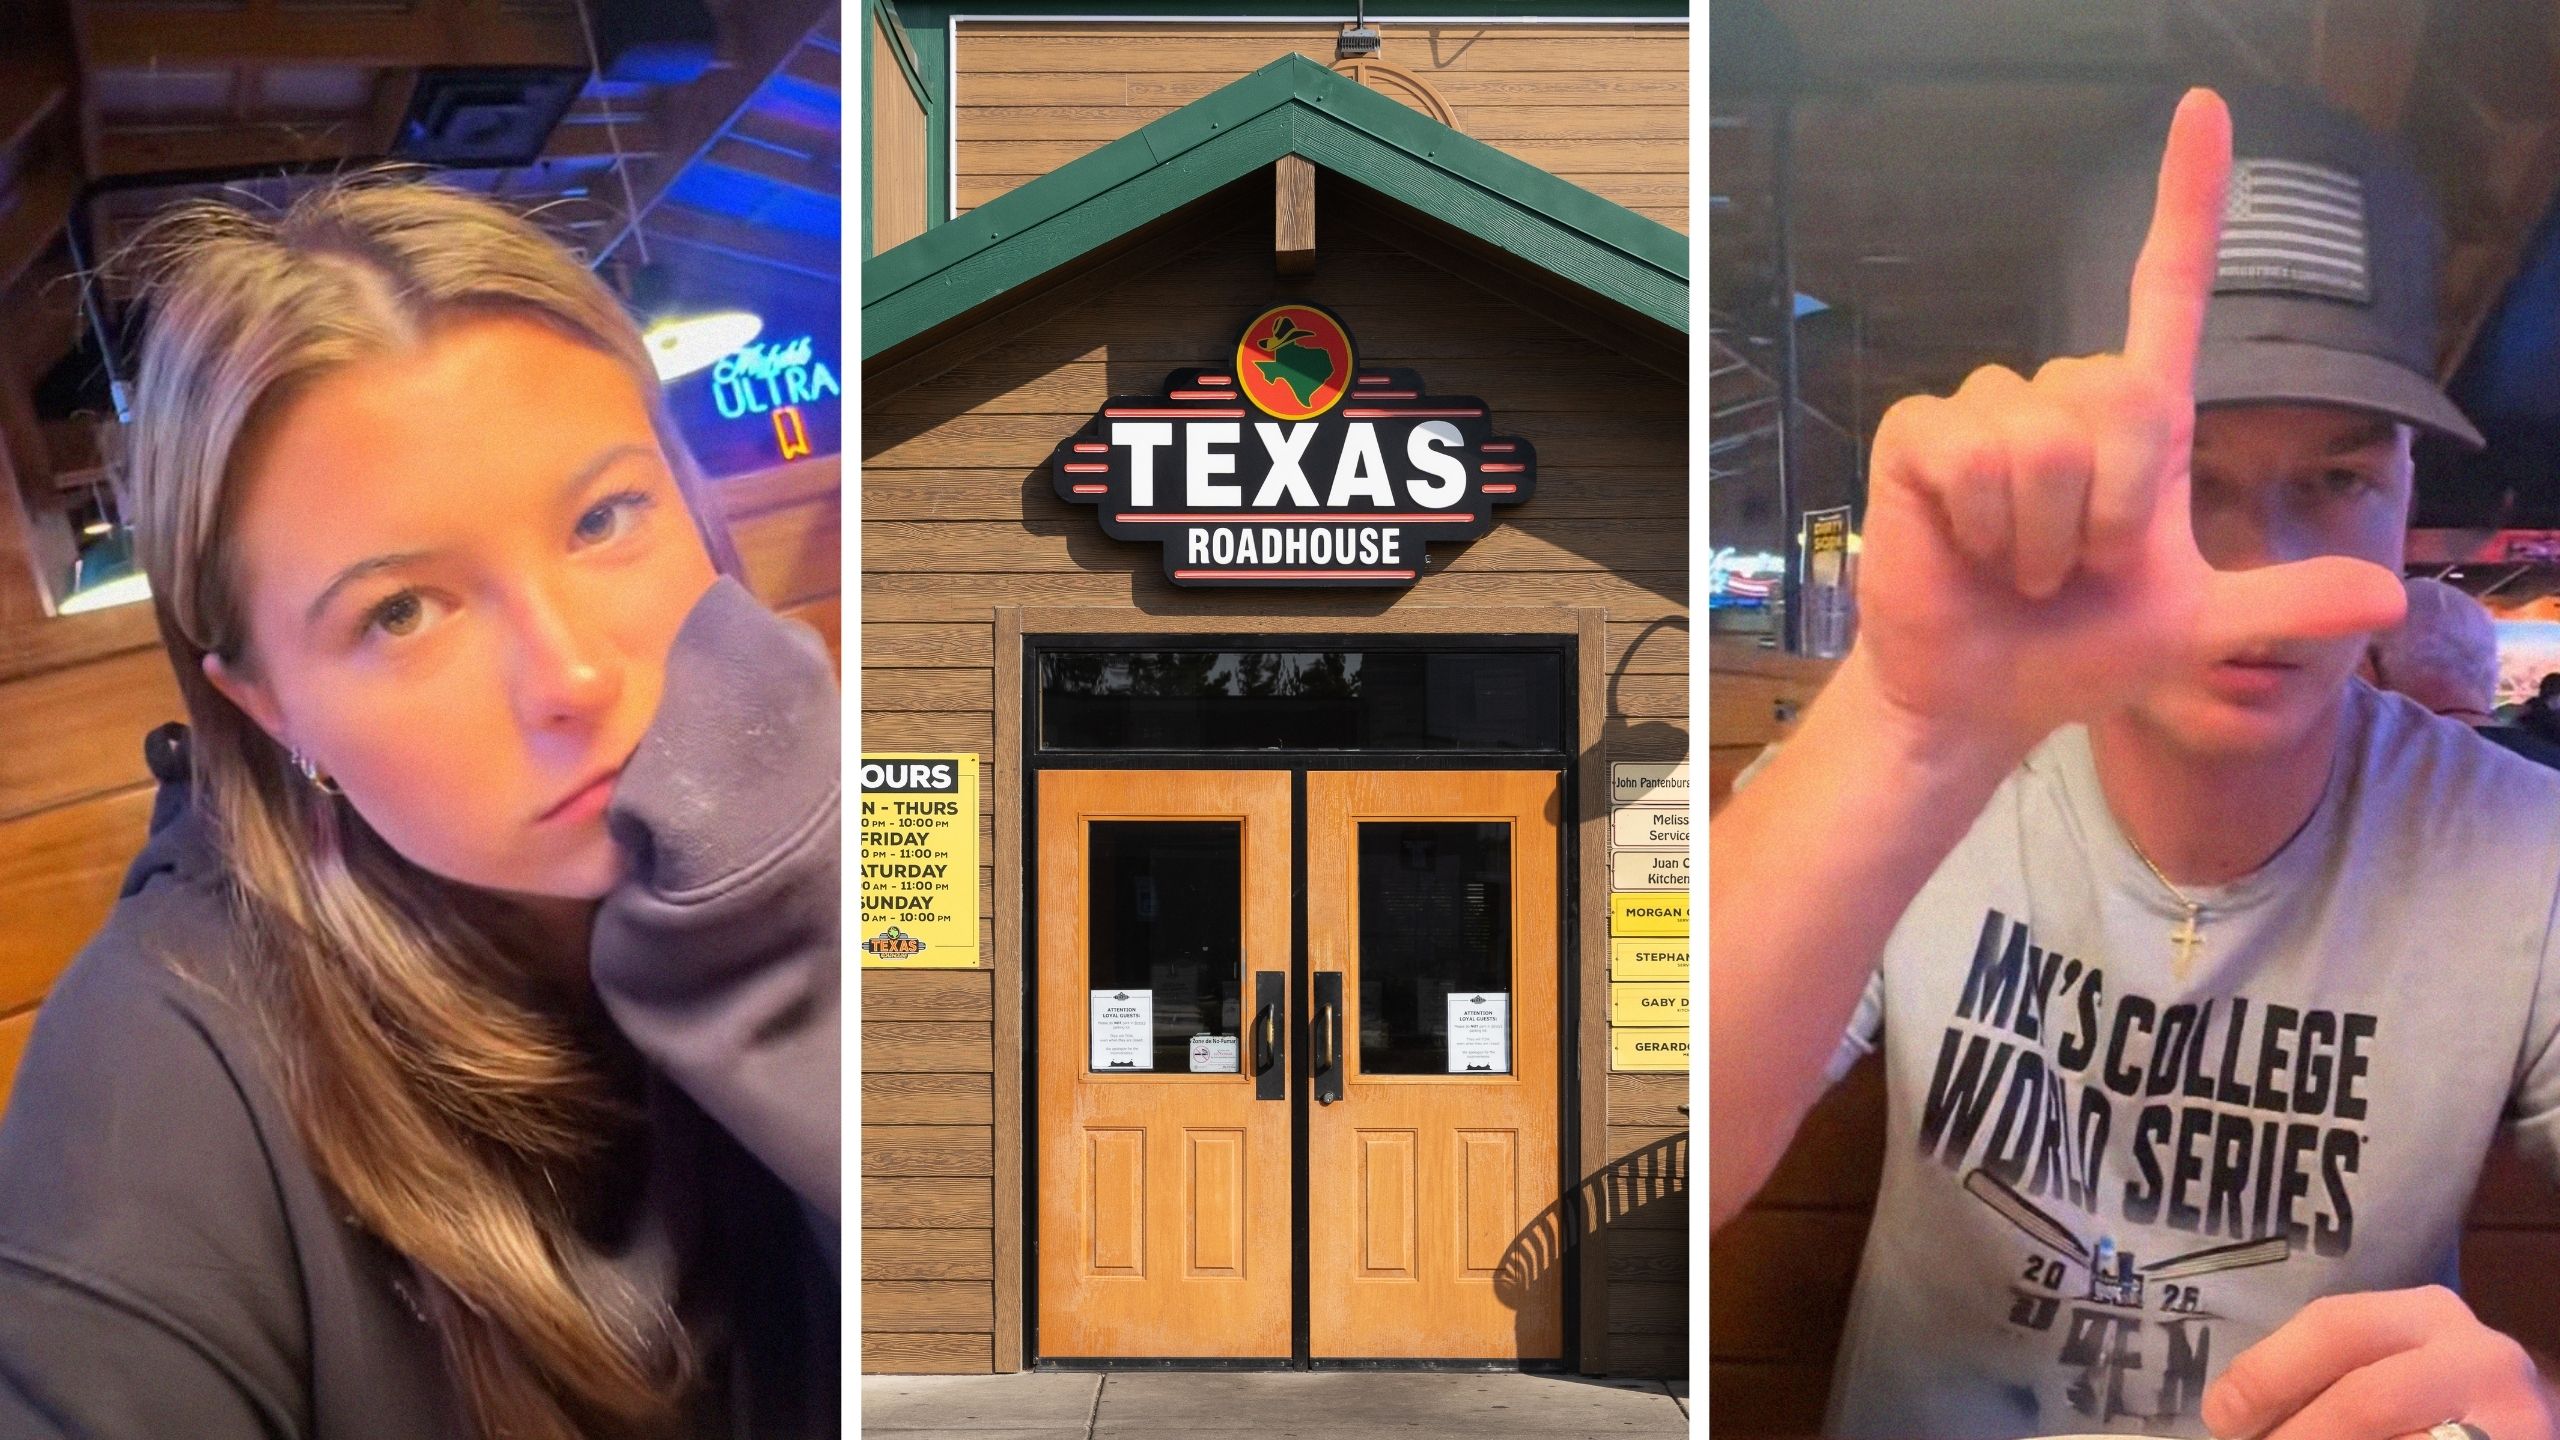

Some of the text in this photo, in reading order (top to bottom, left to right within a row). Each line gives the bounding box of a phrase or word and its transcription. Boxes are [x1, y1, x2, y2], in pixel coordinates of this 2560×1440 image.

[712, 360, 840, 418] ULTRA
[1111, 421, 1467, 508] TEXAS
[1187, 527, 1400, 565] ROADHOUSE
[861, 764, 951, 788] OURS
[1616, 777, 1637, 788] John
[893, 801, 959, 815] THURS
[899, 818, 933, 827] 10:00
[1653, 814, 1689, 825] Meliss
[861, 832, 930, 846] FRIDAY
[900, 849, 931, 858] 11:00
[1652, 858, 1679, 869] Juan
[901, 881, 933, 890] 11:00
[899, 913, 935, 922] 10:00
[1626, 908, 1682, 917] MORGAN
[871, 940, 918, 952] TEXAS
[1641, 998, 1676, 1007] GABY
[1635, 1042, 1690, 1051] GERARD
[2103, 994, 2378, 1120] COLLEGE
[1919, 1027, 2360, 1257] WORLD SERIES
[2022, 1253, 2067, 1291] 20
